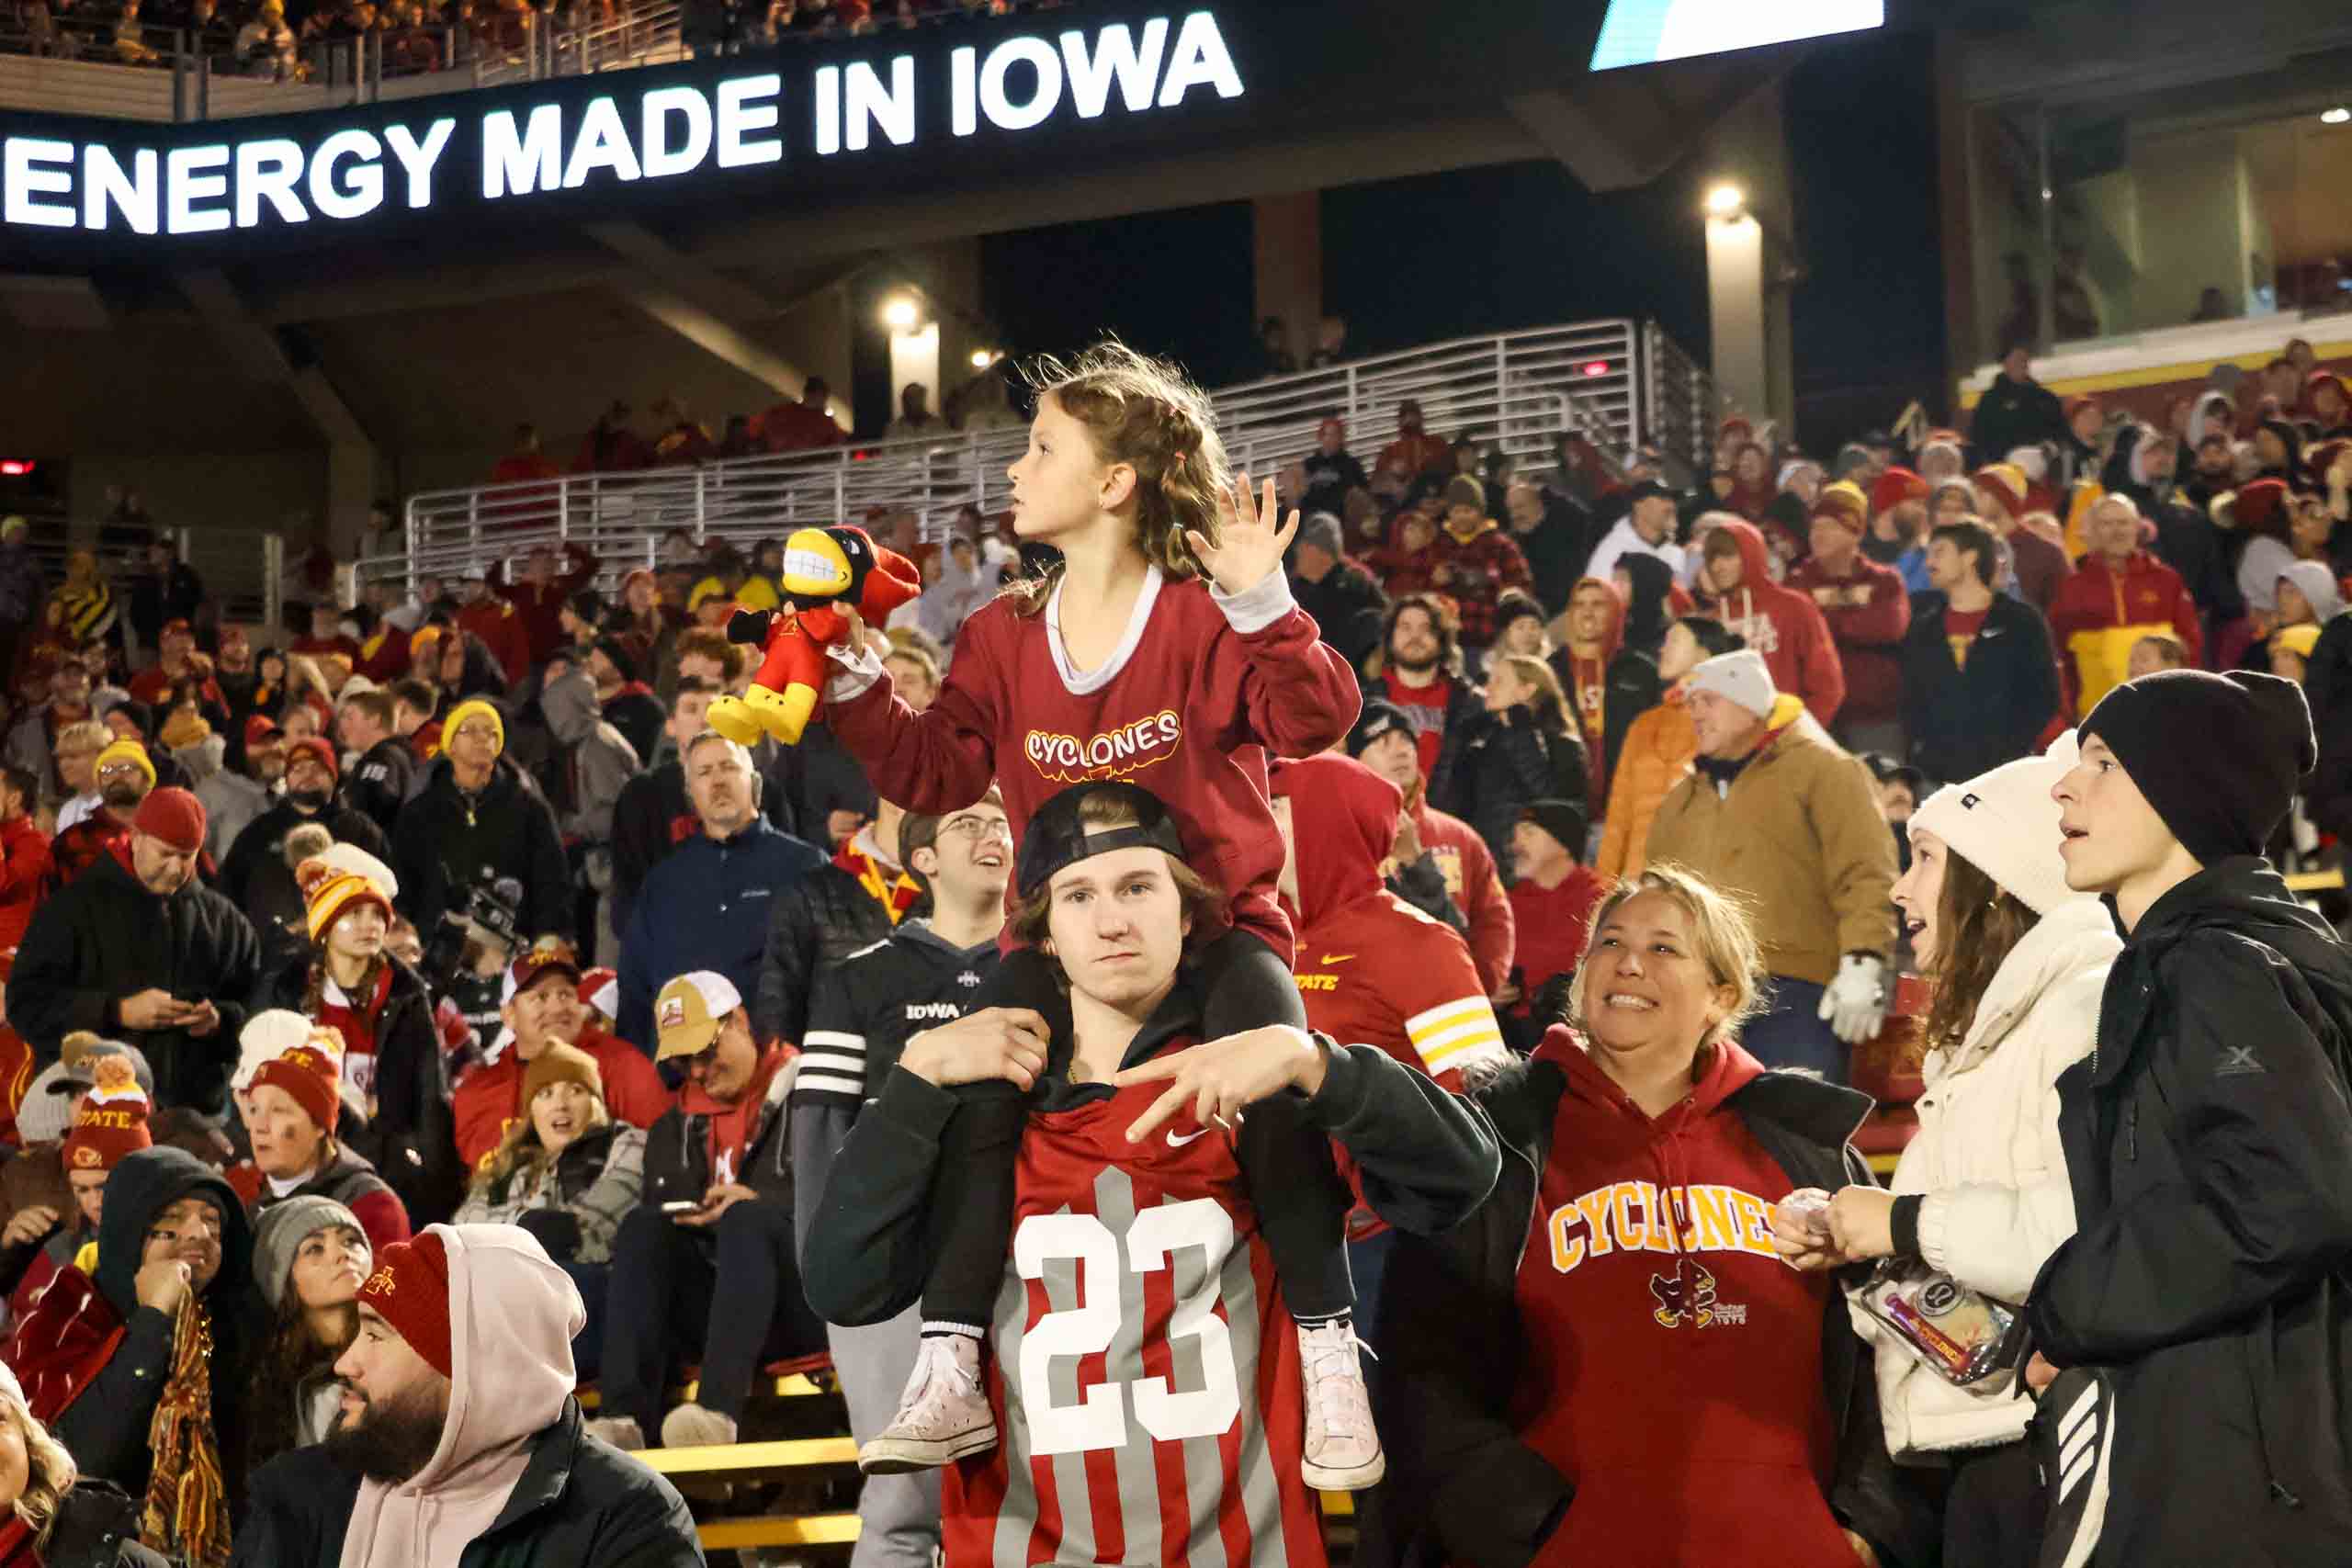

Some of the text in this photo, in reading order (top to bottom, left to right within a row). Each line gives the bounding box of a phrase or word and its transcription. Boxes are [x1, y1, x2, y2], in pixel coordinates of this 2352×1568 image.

[4, 11, 1245, 235] ENERGY MADE IN IOWA
[1028, 713, 1179, 768] CYCLONES
[906, 1002, 960, 1020] IOWA
[1014, 1197, 1241, 1456] 23
